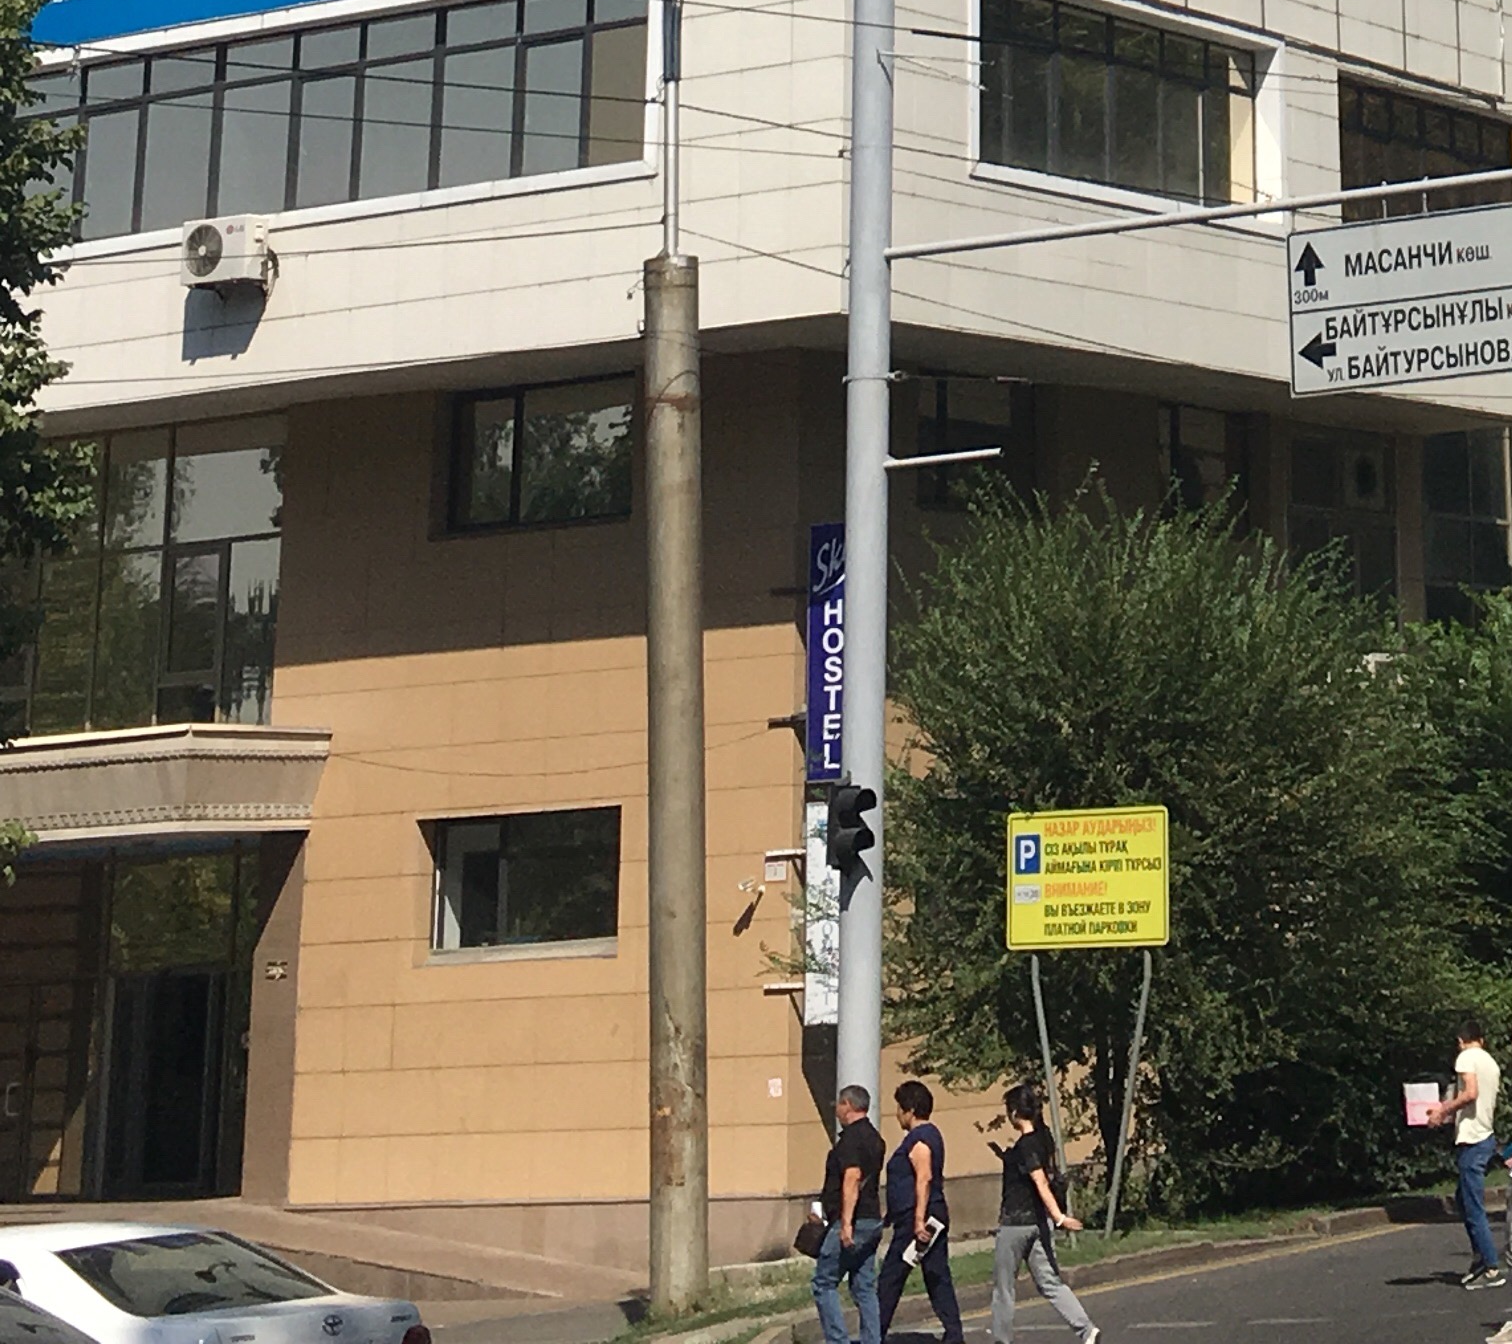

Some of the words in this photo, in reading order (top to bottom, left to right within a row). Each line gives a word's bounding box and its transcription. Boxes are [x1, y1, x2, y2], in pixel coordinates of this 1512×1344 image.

[1344, 242, 1453, 277] МАСАНЧИ
[1294, 289, 1329, 305] 300м
[1325, 296, 1502, 341] БАЙТҰРСЫНҰЛЫ
[822, 599, 845, 770] HOSTEL
[1044, 821, 1080, 837] НАЗАР
[1020, 840, 1036, 870] P
[1045, 881, 1108, 898] ВНИМАНИЕ!
[1044, 904, 1059, 917] ВЫ
[1061, 902, 1116, 917] ВЪЕЗЖАЕТЕ
[1118, 902, 1124, 914] В
[1127, 900, 1151, 914] ЗОНУ
[1044, 919, 1086, 936] ПЛАТНОЙ
[1089, 920, 1138, 934] ПАРКОВКИ
